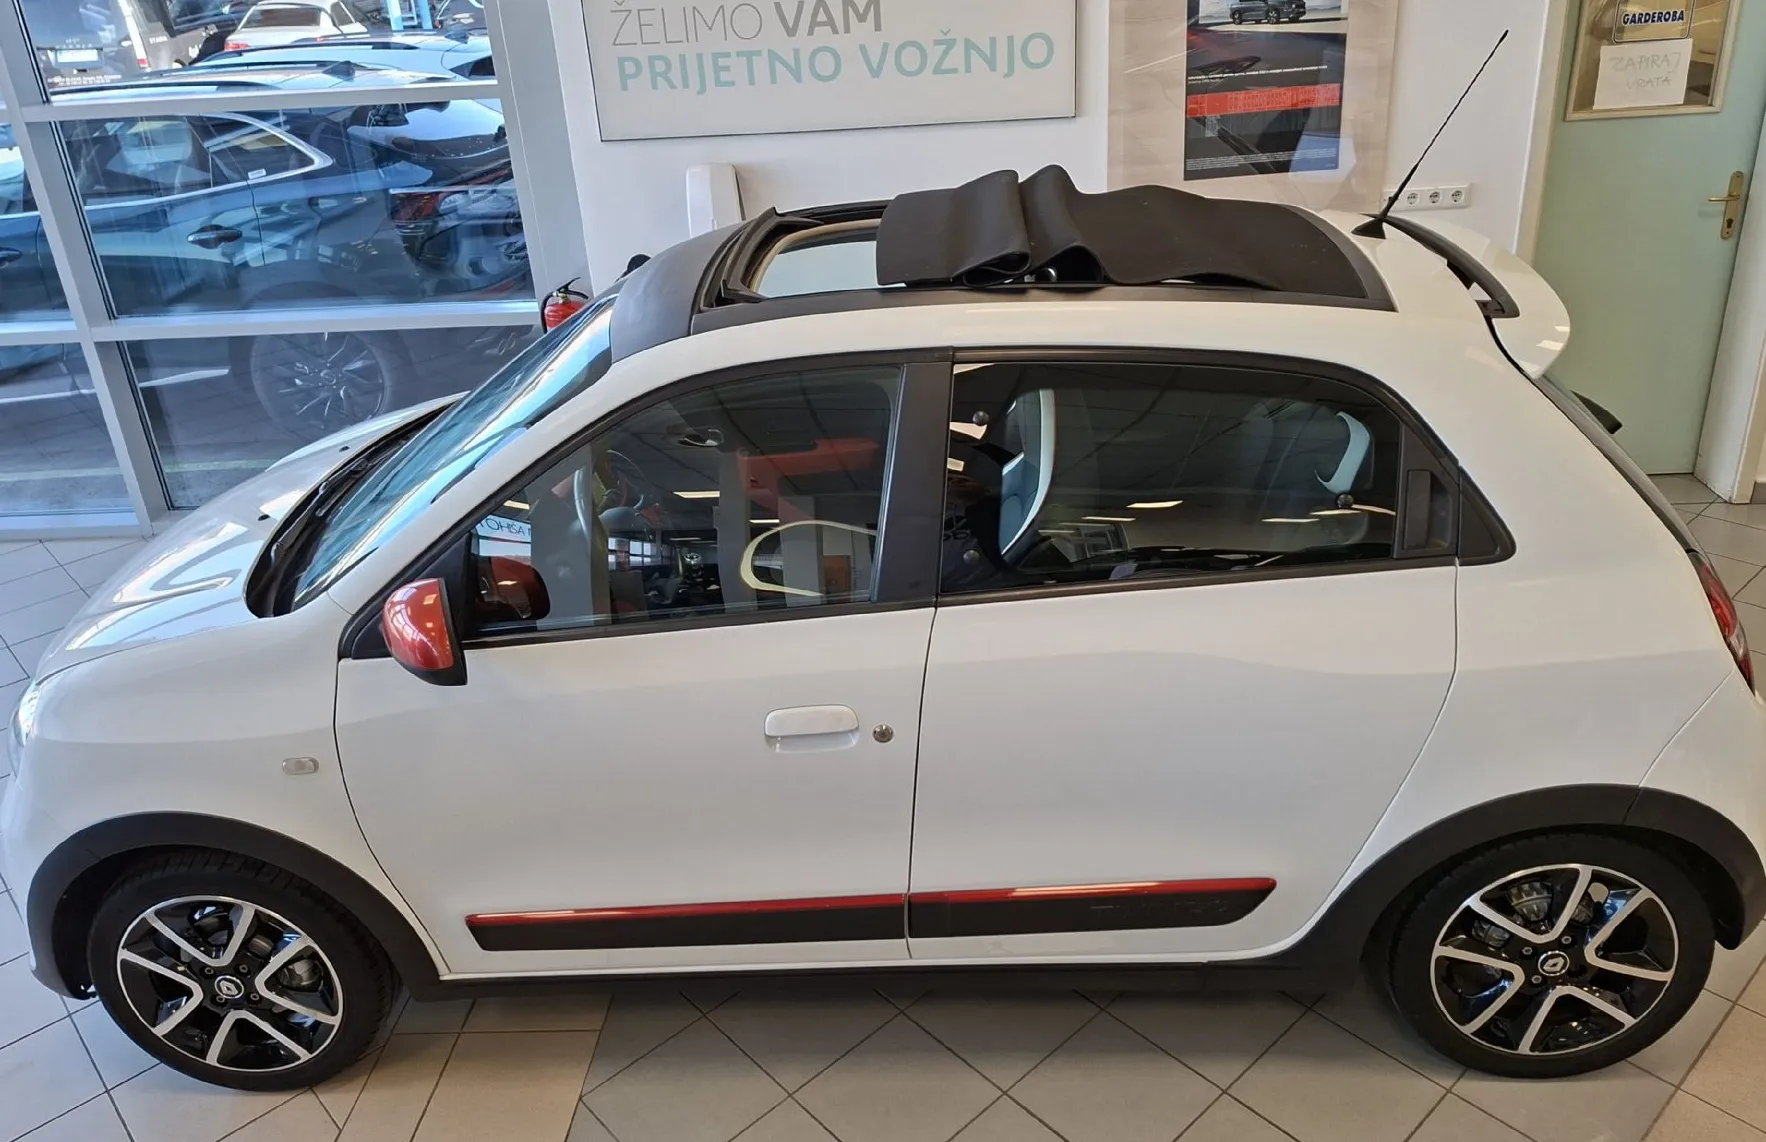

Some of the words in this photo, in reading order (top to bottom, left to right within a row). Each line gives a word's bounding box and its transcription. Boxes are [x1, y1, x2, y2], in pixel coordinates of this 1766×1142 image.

[610, 0, 763, 46] ŽELIMO
[774, 0, 882, 38] VAM
[1622, 10, 1685, 25] GARDEROBA
[617, 46, 842, 95] PRIJETNO
[858, 28, 1055, 79] VOŽNJO
[1609, 52, 1681, 74] ZAPIRAJ
[1626, 76, 1673, 90] VRATA
